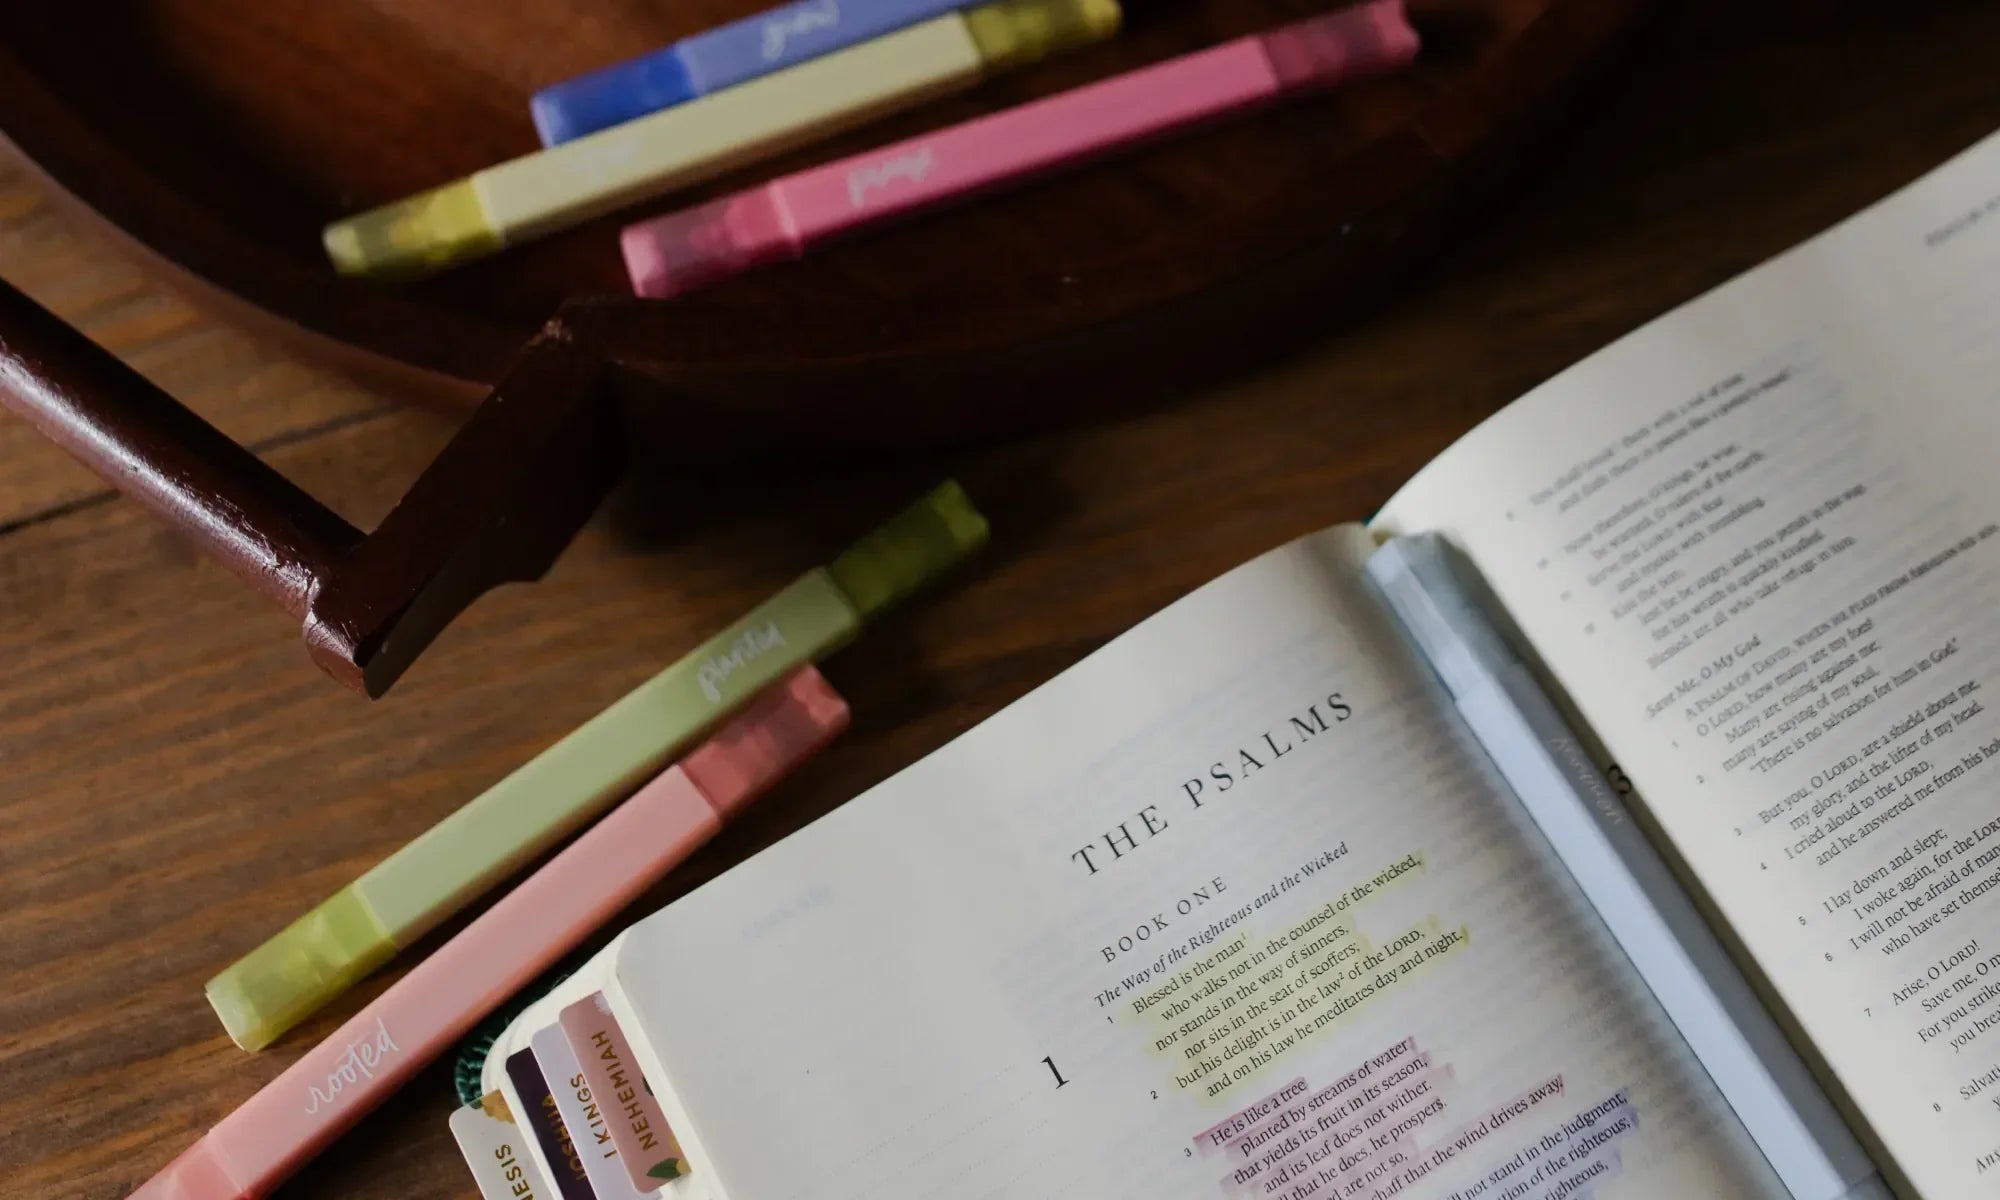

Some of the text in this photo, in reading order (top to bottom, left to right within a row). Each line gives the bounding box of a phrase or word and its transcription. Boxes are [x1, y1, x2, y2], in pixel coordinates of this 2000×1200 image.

[1071, 692, 1353, 876] THE PSALMS
[1783, 847, 1795, 860] I
[1794, 825, 1826, 854] cried
[1824, 802, 1862, 834] aloud
[1859, 795, 1875, 810] to
[1874, 782, 1897, 800] the
[1893, 760, 1934, 788] LORD,
[1094, 841, 1348, 1008] The Way of the Righteous and the Wicked
[1101, 875, 1228, 963] BOOK ONE
[1799, 828, 1948, 926] 5 I lay down and slept;
[1825, 859, 1975, 963] 6 I will not be afraid of
[1853, 836, 1976, 921] I woke again, for the
[1161, 854, 1422, 1021] who walks not in the counsel of the wicked,
[1881, 900, 1961, 955] who have set
[1106, 1016, 1114, 1024] 1
[1132, 977, 1180, 1015] Blessed
[1178, 972, 1193, 985] is
[1192, 958, 1216, 977] the
[1150, 1090, 1158, 1099] 2
[1175, 1068, 1203, 1089] but
[1199, 1055, 1223, 1075] his
[1223, 1026, 1269, 1061] delight
[1267, 1018, 1281, 1032] is
[1279, 1009, 1297, 1024] in
[1296, 994, 1319, 1013] the
[1348, 961, 1363, 980] of
[1362, 952, 1386, 971] the
[1383, 930, 1425, 957] LORD,
[1155, 1030, 1179, 1051] nor
[1179, 1005, 1221, 1037] stands
[1219, 996, 1237, 1011] in
[1235, 981, 1259, 1001] the
[1257, 964, 1283, 985] way
[1285, 950, 1299, 969] of
[1184, 942, 1360, 1059] nor sits in the seat of scoffers;
[1206, 931, 1463, 1097] and on his law he meditates day and night.
[1864, 939, 1980, 1018] 7 Arise, O LORD!
[1917, 1022, 1942, 1043] For
[1941, 1006, 1969, 1031] you
[1921, 962, 1989, 1013] Save me, O
[305, 1016, 399, 1114] rooted
[1041, 1054, 1070, 1090] 1
[1950, 1029, 1976, 1054] you
[570, 1072, 617, 1159] I KINGS
[591, 1030, 659, 1152] NEHEMIAH
[1185, 1078, 1308, 1157] 3 He is like a tree
[1234, 1058, 1428, 1185] that yields its fruit in its season,
[1240, 1040, 1408, 1157] planted by streams of water
[1263, 1168, 1290, 1194] and
[1288, 1159, 1308, 1177] its
[1305, 1139, 1332, 1166] leaf
[1333, 1124, 1363, 1149] does
[1363, 1108, 1388, 1129] not
[1386, 1080, 1432, 1113] wither.
[1403, 1161, 1432, 1184] that
[1431, 1146, 1456, 1166] the
[1454, 1121, 1490, 1151] wind
[1490, 1099, 1529, 1129] drives
[1528, 1076, 1564, 1105] away.
[1933, 1103, 1942, 1113] 8
[1343, 1152, 1409, 1197] are not so,
[1464, 1179, 1488, 1200] not
[1488, 1153, 1525, 1185] stand
[1522, 1146, 1541, 1162] in
[1539, 1132, 1564, 1152] the
[1561, 1093, 1628, 1140] judgment,
[1530, 1118, 1631, 1186] of the righteous;
